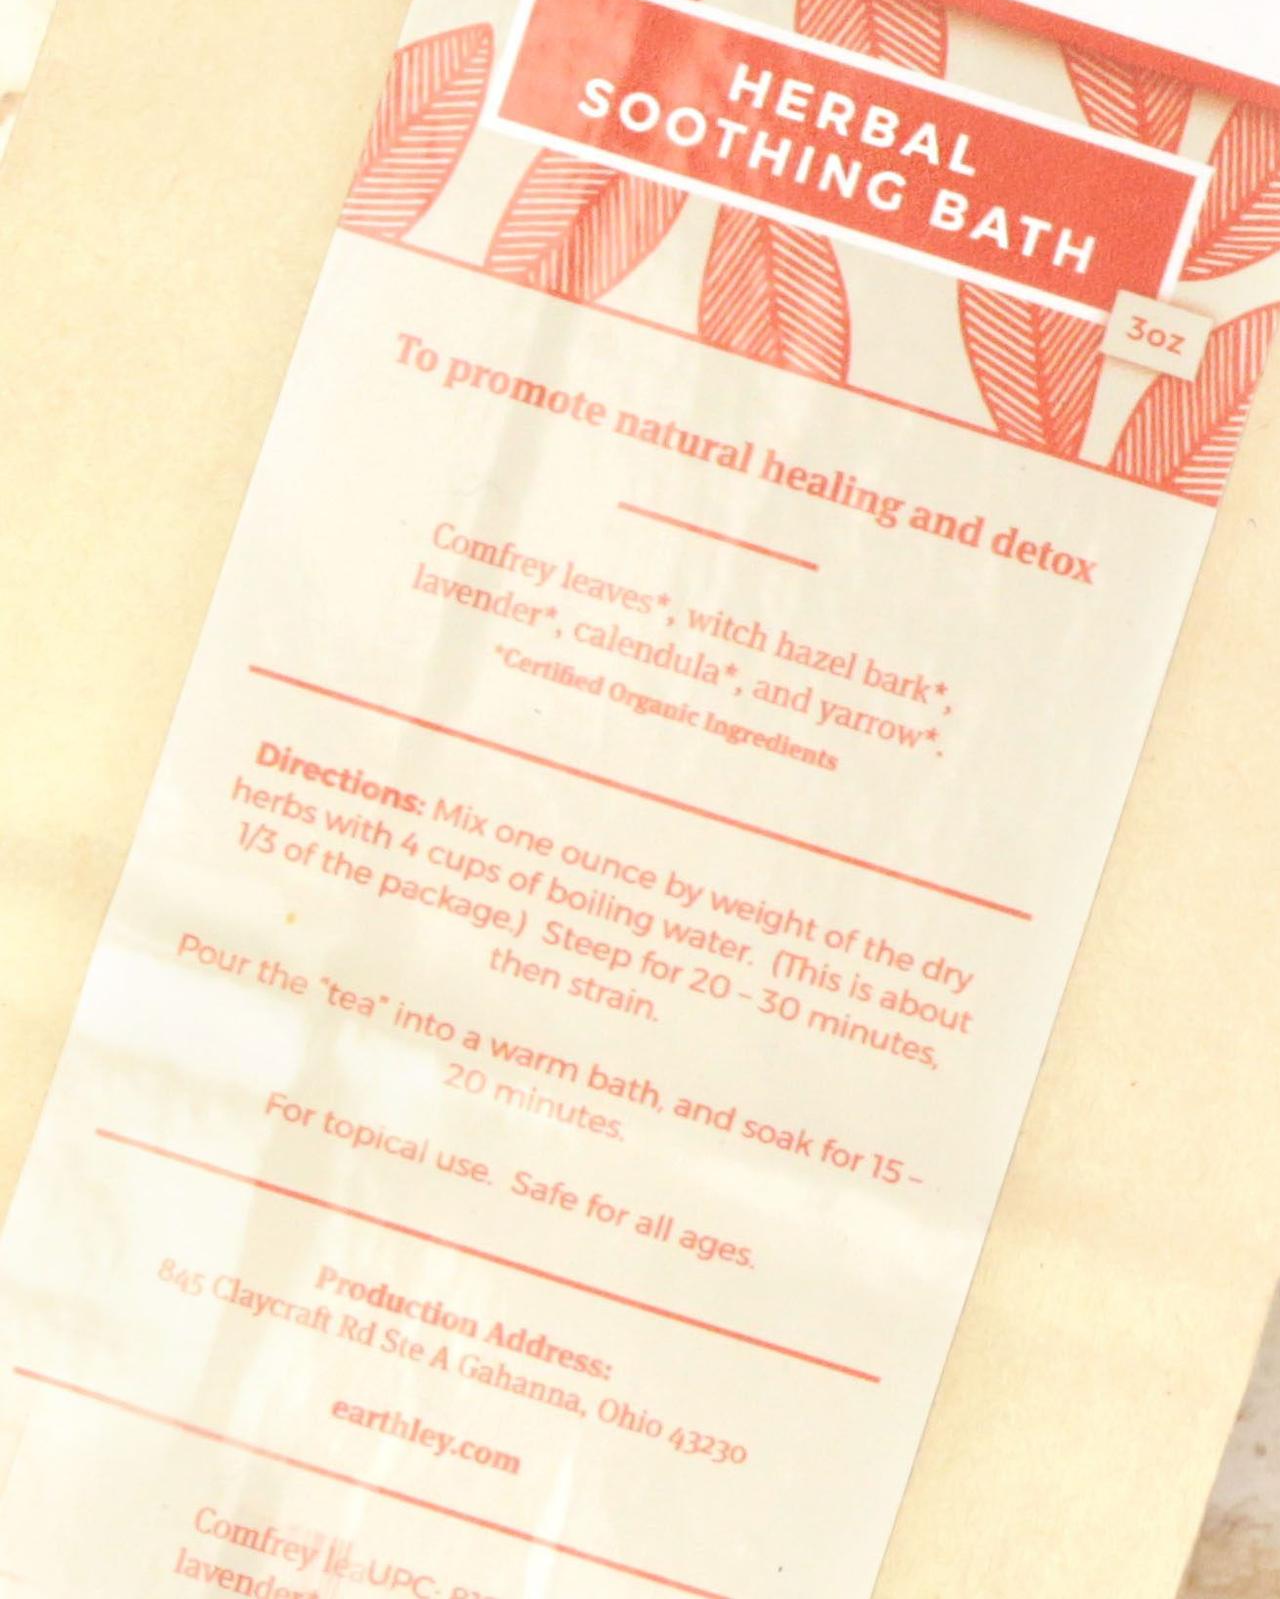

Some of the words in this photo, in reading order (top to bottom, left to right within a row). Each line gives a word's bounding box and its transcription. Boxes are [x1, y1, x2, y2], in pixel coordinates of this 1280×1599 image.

[576, 75, 907, 211] SOOTHING
[929, 188, 1096, 274] BATH
[728, 63, 976, 177] HERBAL
[1127, 315, 1186, 356] 3oz
[396, 331, 441, 374] To
[445, 357, 608, 427] promote
[613, 411, 756, 475] natural
[761, 449, 905, 530] healing
[907, 505, 987, 550] and
[990, 526, 1095, 584] detox
[432, 522, 554, 586] Comfrey
[687, 607, 770, 653] witch
[774, 630, 859, 681] hazel
[608, 682, 702, 726] Organic
[704, 712, 840, 772] Ingredients
[751, 680, 815, 716] and
[233, 774, 318, 826] herbs
[324, 813, 396, 849] with
[400, 830, 420, 857] 4
[427, 843, 502, 885] cups
[506, 869, 545, 897] of
[545, 876, 657, 939] boiling
[662, 919, 752, 963] water.
[771, 947, 842, 994] (This
[848, 977, 874, 1004] is
[878, 988, 974, 1035] about
[255, 740, 426, 817] Directions:
[431, 797, 488, 835] Mix
[493, 822, 556, 858] one
[559, 843, 659, 889] ounce
[663, 871, 705, 910] by
[710, 890, 818, 943] weight
[822, 927, 860, 952] of
[862, 936, 917, 971] the
[919, 954, 975, 997] dry
[238, 819, 280, 856] 1/3
[281, 840, 319, 866] of
[320, 849, 375, 887] the
[377, 871, 529, 938] package.)
[541, 918, 634, 972] Steep
[640, 948, 685, 984] for
[686, 965, 734, 1000] 20
[759, 987, 803, 1023] 30
[806, 1008, 939, 1072] minutes,
[488, 947, 563, 990] then
[568, 975, 657, 1022] strain.
[176, 930, 251, 977] Pour
[255, 957, 311, 997] the
[393, 1006, 458, 1043] into
[461, 1030, 483, 1052] a
[489, 1037, 581, 1082] warm
[585, 1062, 665, 1113] bath,
[673, 1096, 738, 1134] and
[743, 1117, 814, 1158] soak
[820, 1136, 866, 1171] for
[871, 1152, 905, 1186] 15
[444, 1060, 489, 1094] 20
[265, 1090, 318, 1128] For
[321, 1108, 429, 1164] topical
[434, 1151, 491, 1186] use.
[511, 1170, 581, 1213] Safe
[585, 1192, 630, 1227] for
[635, 1214, 676, 1242] all
[678, 1229, 753, 1269] ages.
[157, 1258, 204, 1297] 845
[212, 1273, 333, 1334] Claycraft
[338, 1313, 380, 1347] Rd
[382, 1325, 428, 1360] Ste
[428, 1344, 450, 1373] A
[458, 1355, 589, 1420] Gahanna,
[596, 1396, 665, 1440] Ohio
[667, 1426, 750, 1466] 43230
[317, 1269, 479, 1339] Production
[486, 1320, 612, 1382] Address:
[330, 1399, 522, 1475] earthley.com
[193, 1506, 321, 1572] Comfrey
